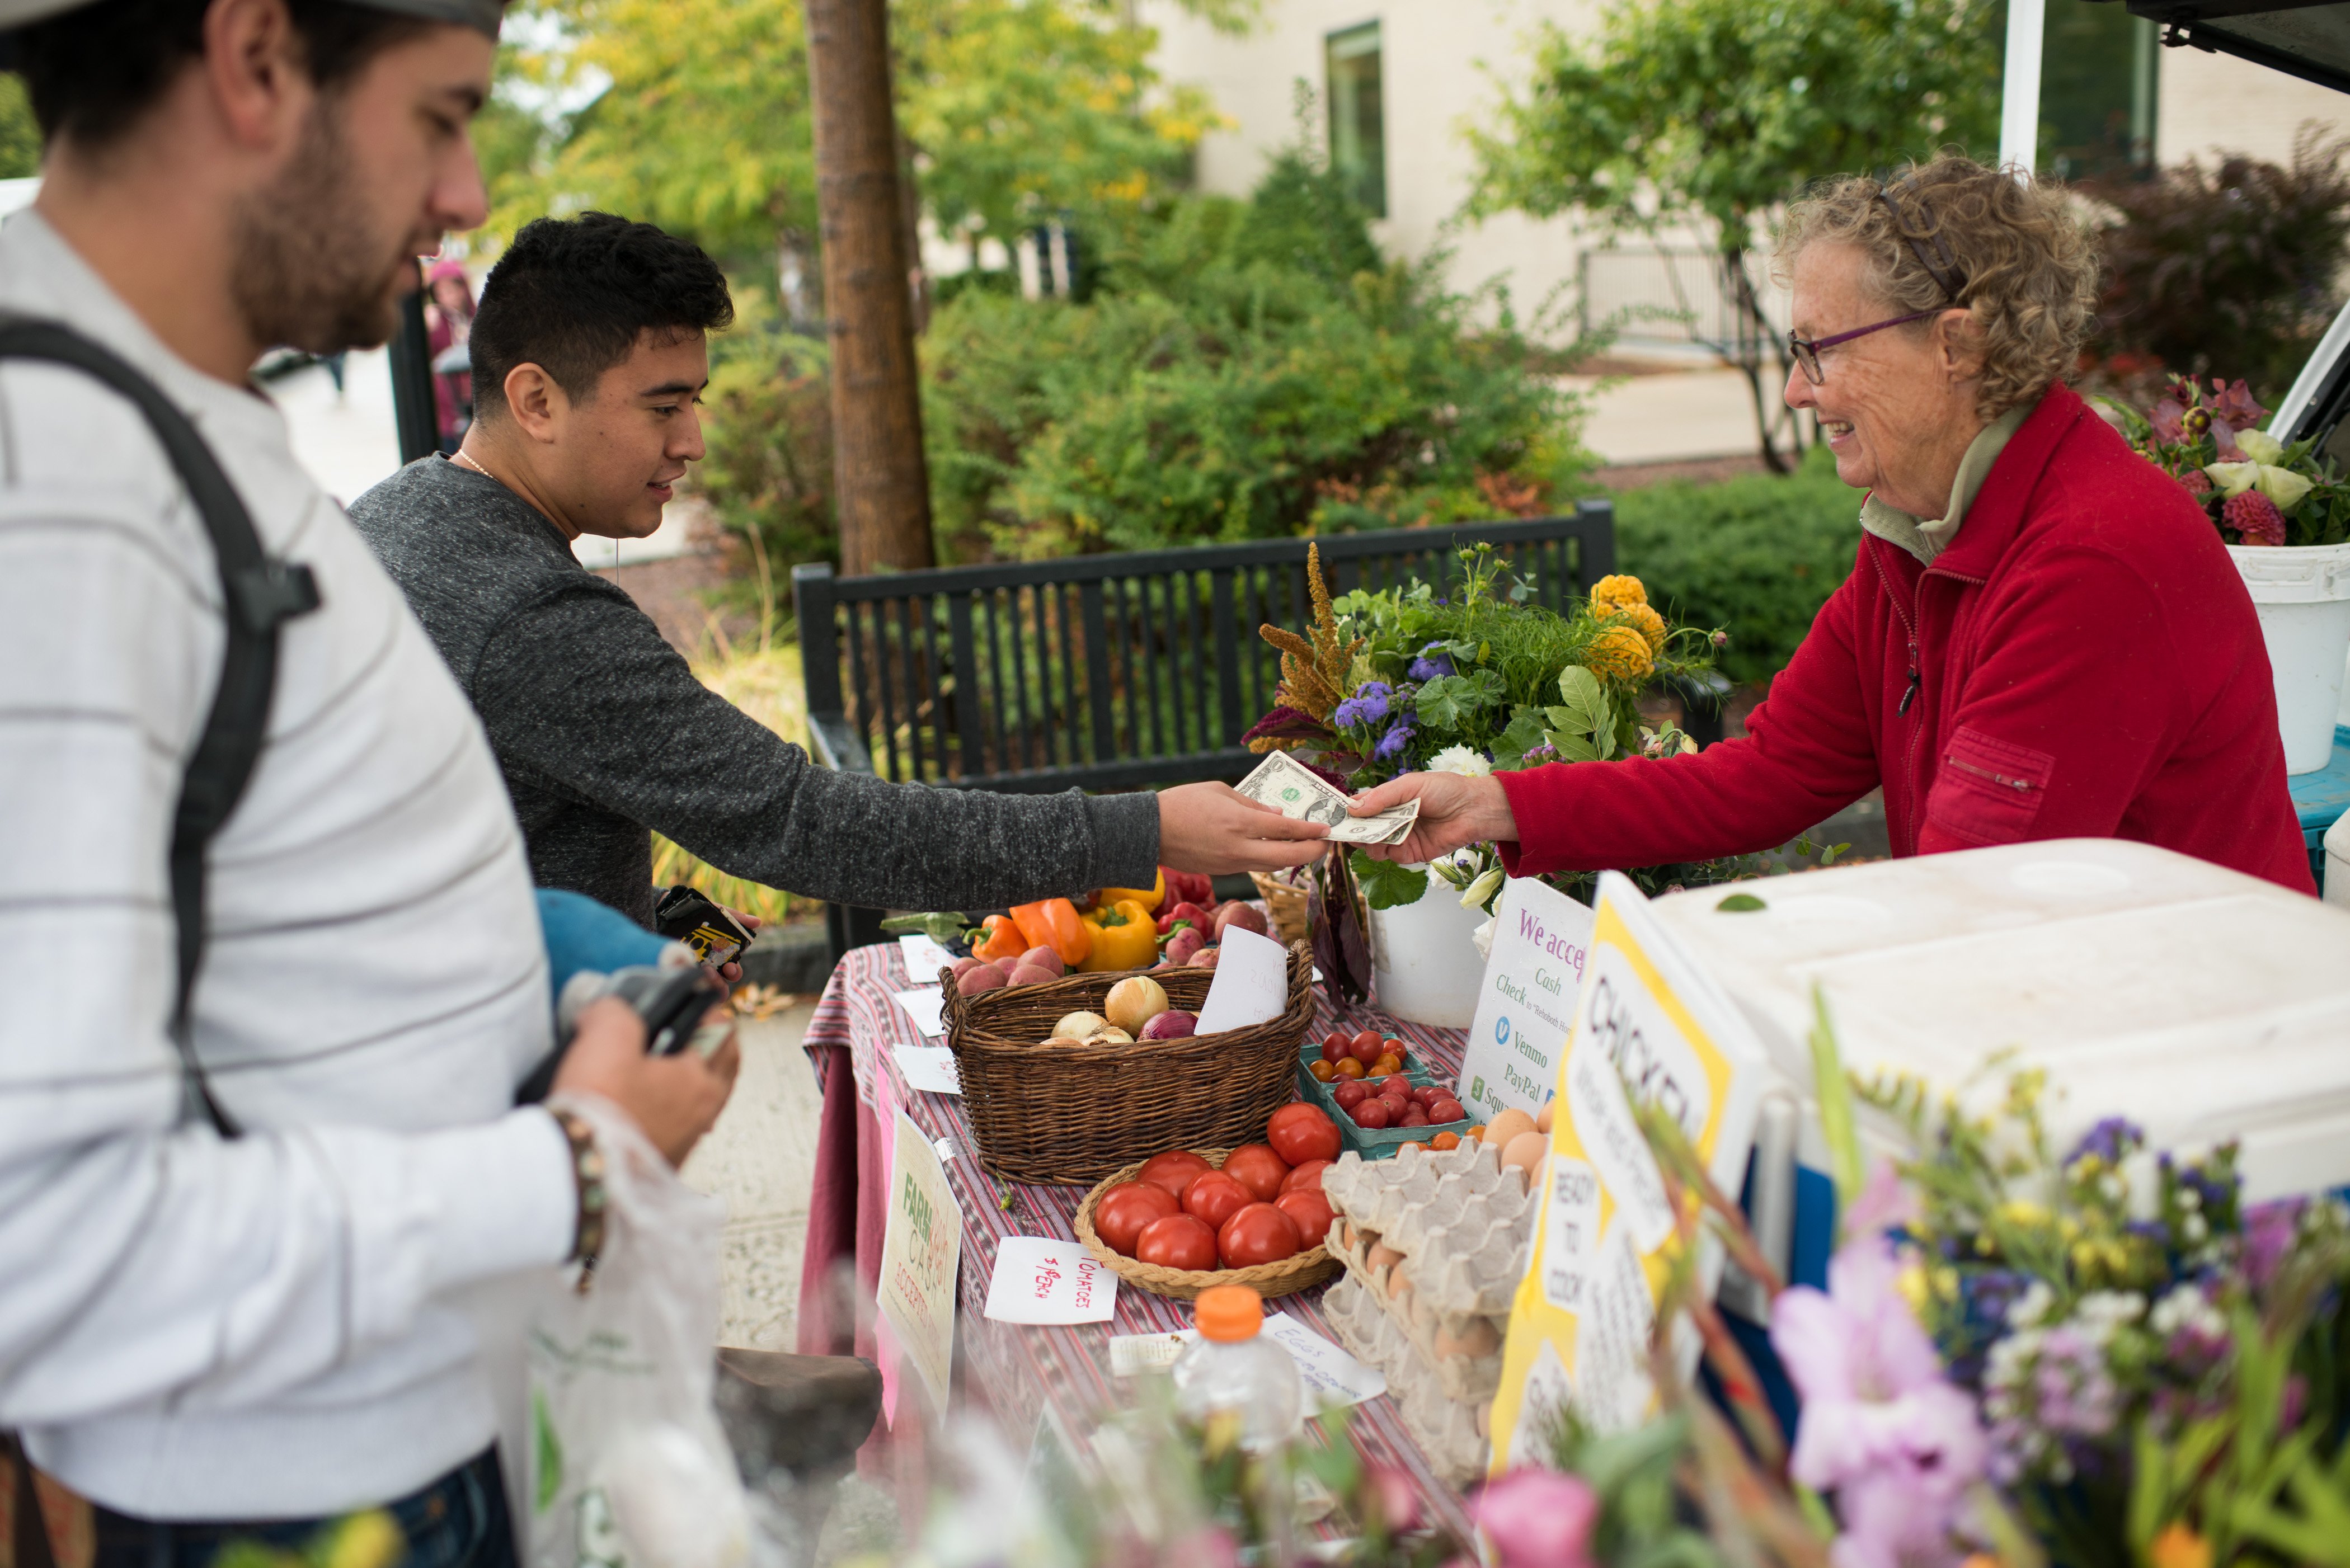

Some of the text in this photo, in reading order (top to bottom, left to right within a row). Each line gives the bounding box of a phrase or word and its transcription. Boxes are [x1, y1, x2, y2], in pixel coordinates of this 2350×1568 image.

[1520, 908, 1544, 947] We
[1496, 974, 1527, 1006] Check
[1526, 1001, 1532, 1010] to
[1535, 968, 1562, 996] Cash
[1514, 1030, 1548, 1068] Venmo
[1503, 1063, 1541, 1103] PayPal
[903, 1171, 933, 1248] FARM
[909, 1228, 937, 1308] CASH
[1075, 1257, 1104, 1309] TOMATOES
[1274, 1328, 1326, 1358] EGGS
